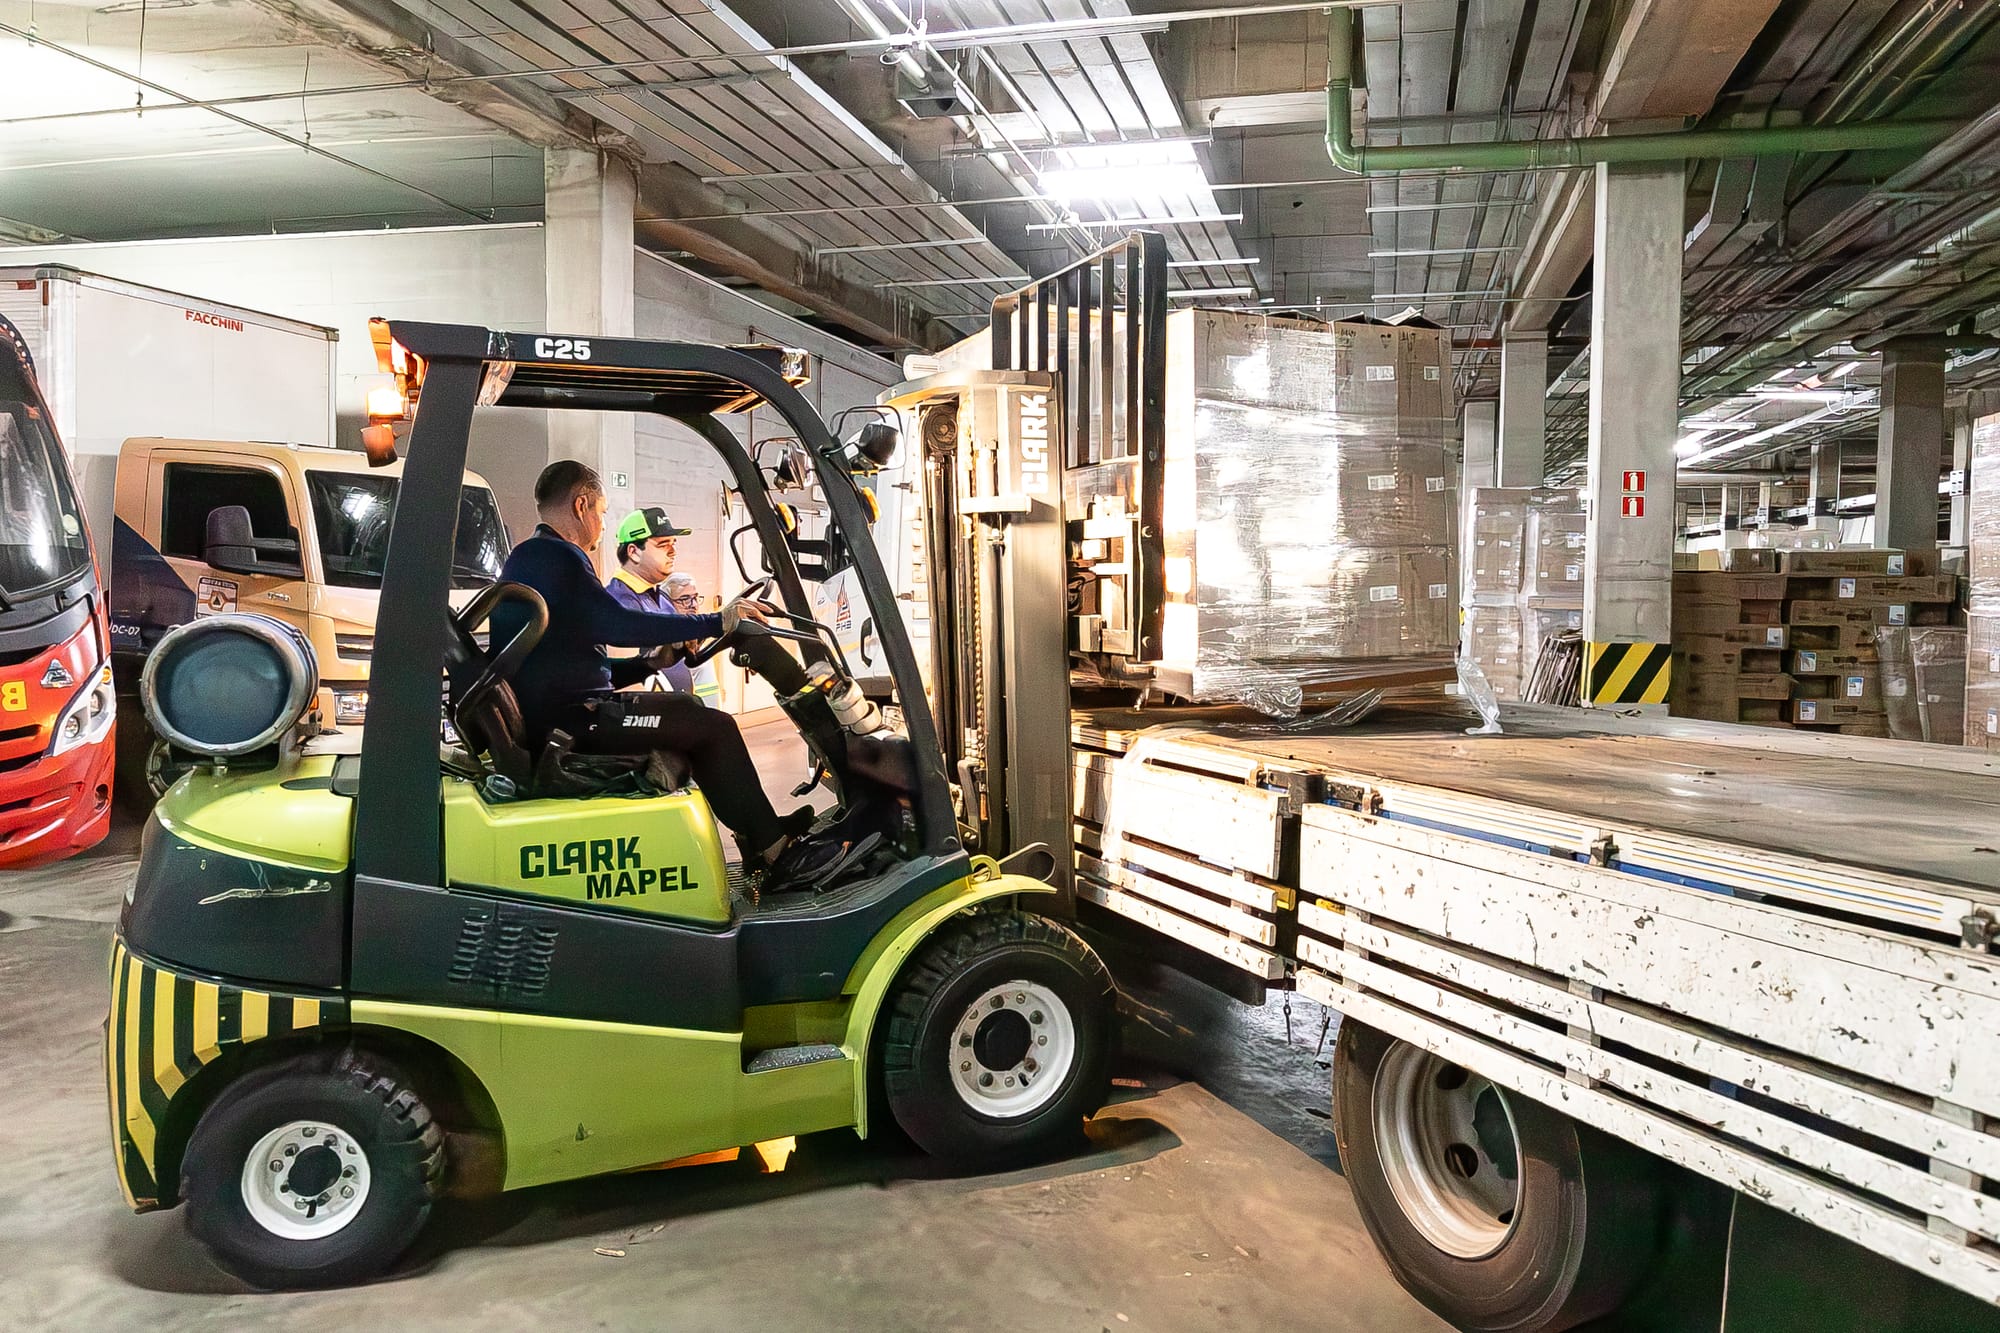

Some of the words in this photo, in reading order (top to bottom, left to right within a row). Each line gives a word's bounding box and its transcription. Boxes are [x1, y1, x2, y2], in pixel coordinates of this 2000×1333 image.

[185, 310, 244, 332] FACCHINI
[535, 337, 591, 360] C25
[1020, 394, 1048, 494] CLARK
[622, 715, 661, 728] NIKE
[519, 836, 642, 880] CLARK
[586, 865, 699, 900] MAPEL
